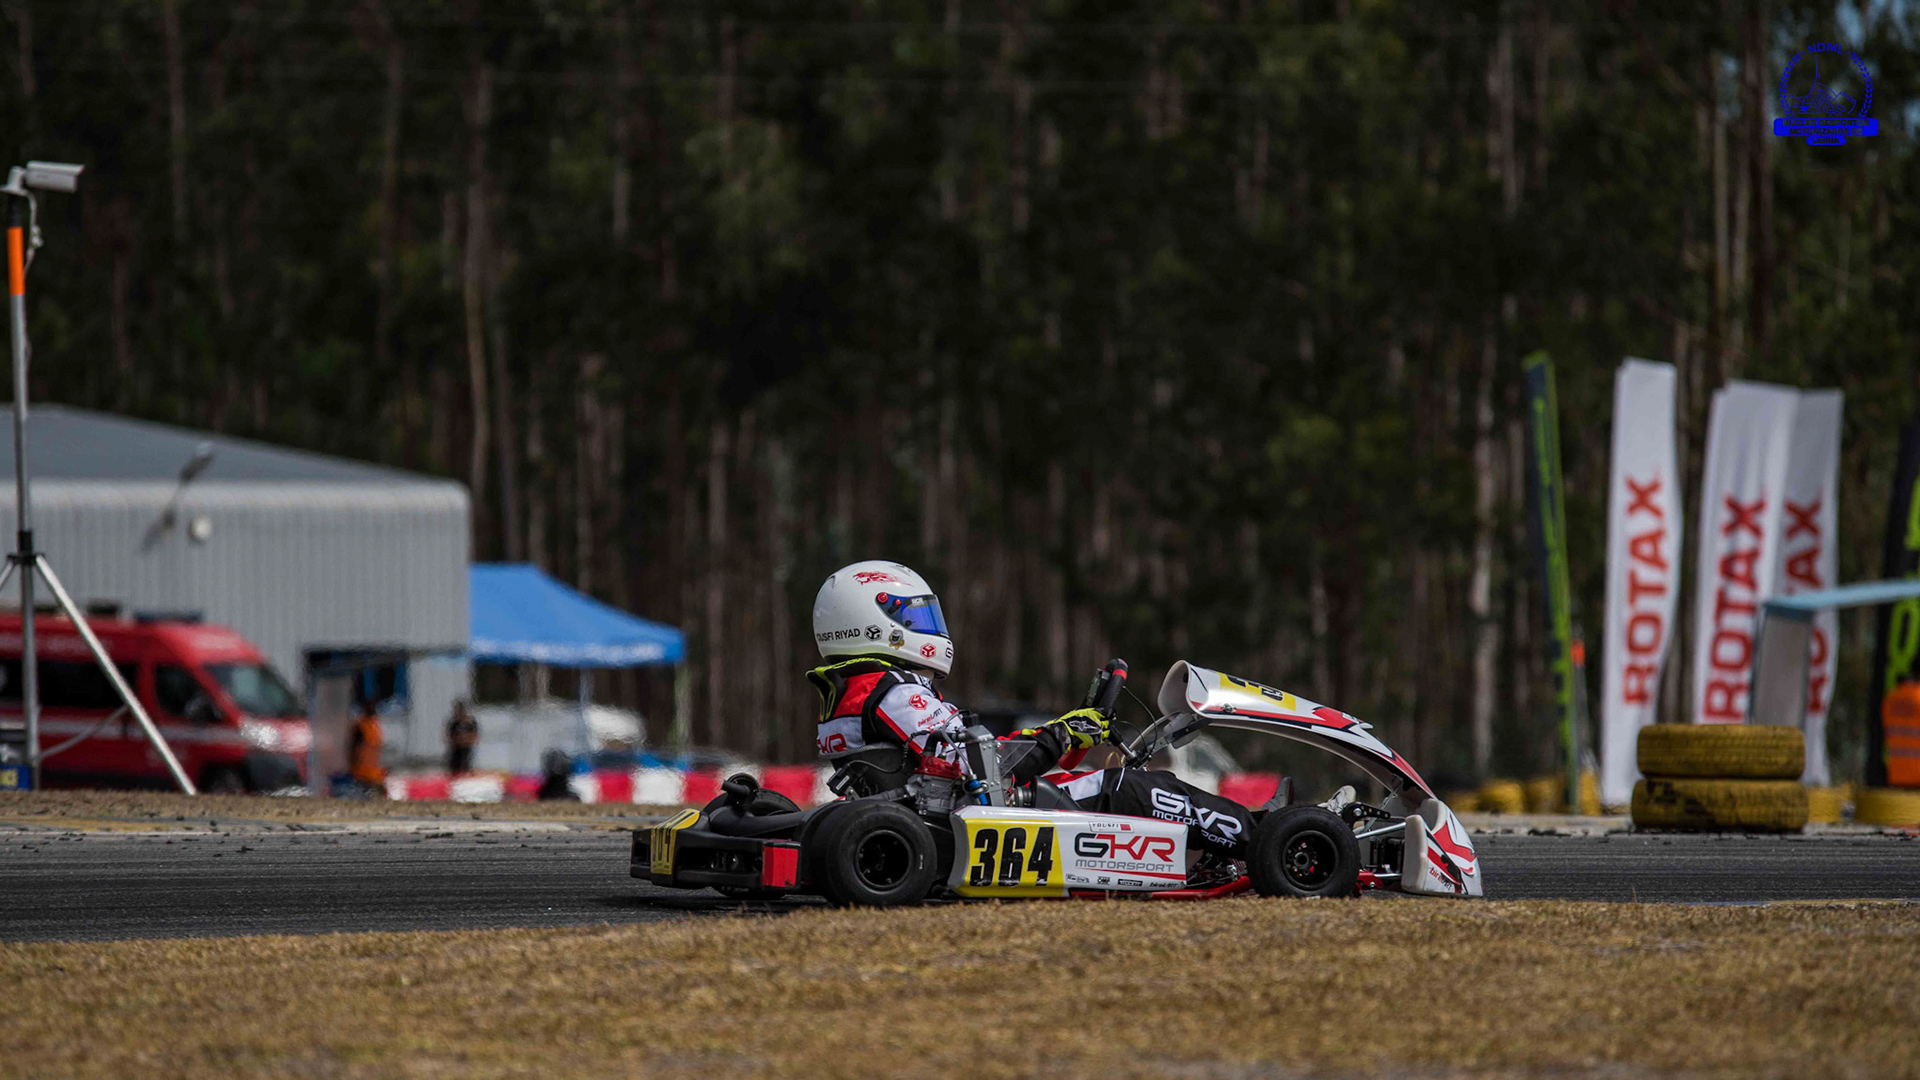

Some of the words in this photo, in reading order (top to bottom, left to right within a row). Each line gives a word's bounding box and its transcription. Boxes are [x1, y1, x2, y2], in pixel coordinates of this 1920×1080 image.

[1622, 475, 1670, 707] ROTAX
[1703, 495, 1767, 724] ROTAX
[816, 631, 834, 642] OUSFI
[834, 628, 861, 641] RIYAD
[817, 733, 847, 753] KR
[1151, 787, 1242, 842] GKR
[969, 826, 1055, 888] 364
[1074, 832, 1175, 862] GKR
[1075, 859, 1174, 872] MOTORSPORT
